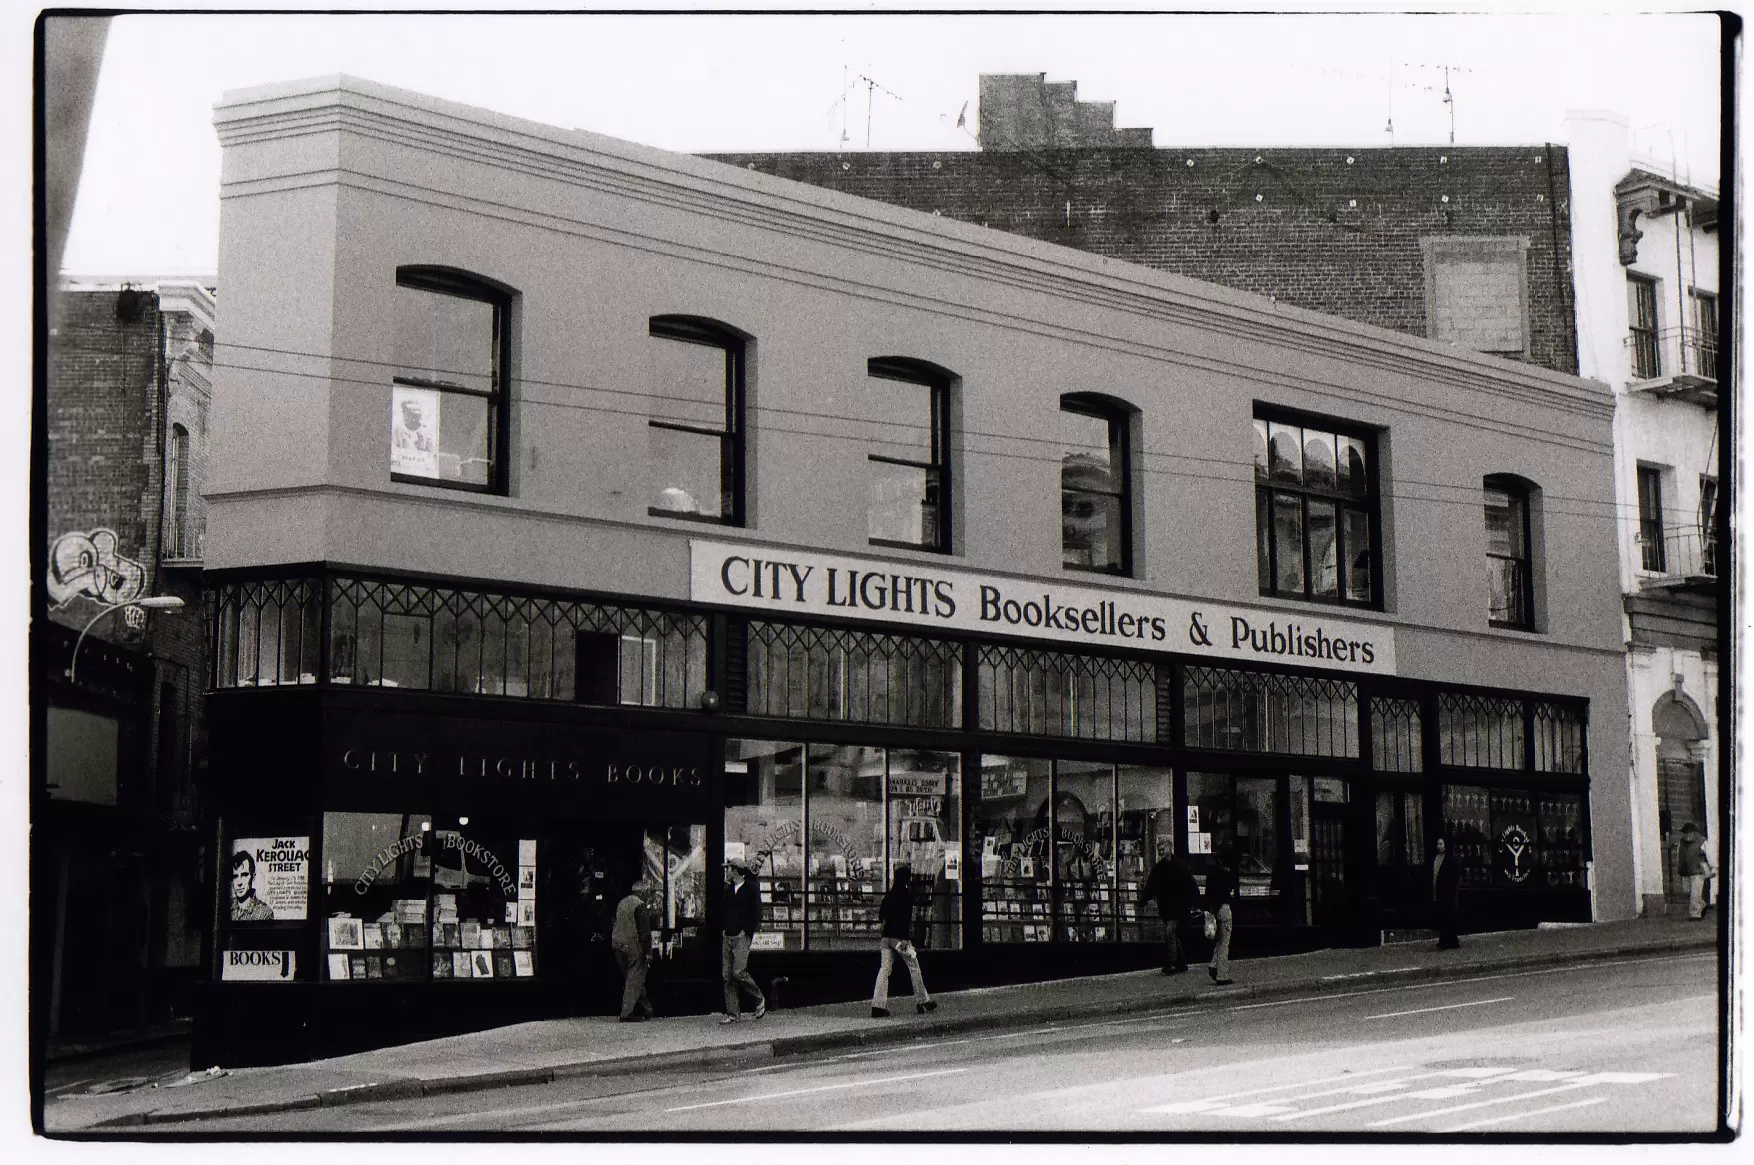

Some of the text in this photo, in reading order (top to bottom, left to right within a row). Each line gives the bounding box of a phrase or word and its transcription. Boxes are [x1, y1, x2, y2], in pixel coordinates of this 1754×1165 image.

[721, 555, 1375, 664] CITY LIGHTS Booksellers & Publishers
[343, 749, 702, 787] CITY LIGHTS BOOKS
[272, 839, 295, 849] JACK
[268, 863, 301, 871] STREET
[354, 833, 517, 897] CITY LIGHTS BOOKSTORE
[229, 951, 281, 966] BOOKS
